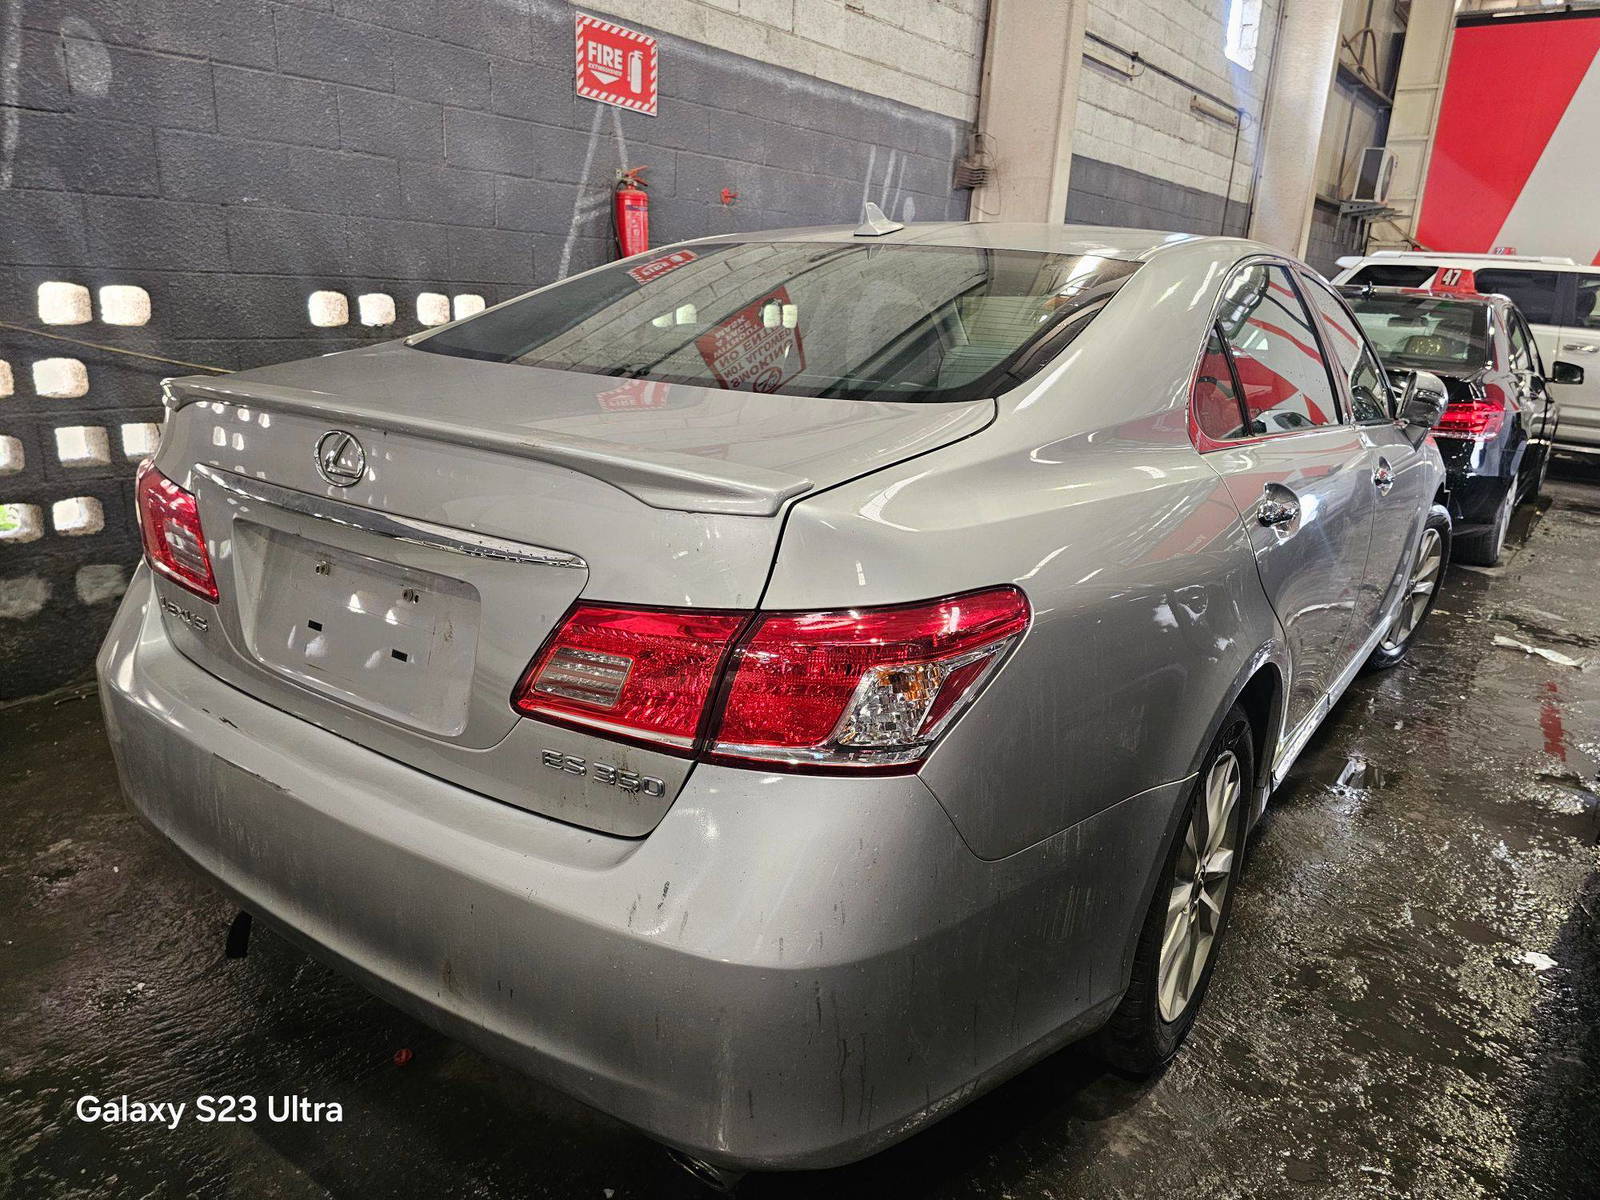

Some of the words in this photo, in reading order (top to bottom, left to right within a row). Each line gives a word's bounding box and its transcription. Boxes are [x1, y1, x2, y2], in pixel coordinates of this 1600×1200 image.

[588, 40, 623, 70] FIRE
[1441, 268, 1462, 286] 47
[541, 747, 587, 776] ES
[593, 761, 665, 798] 350
